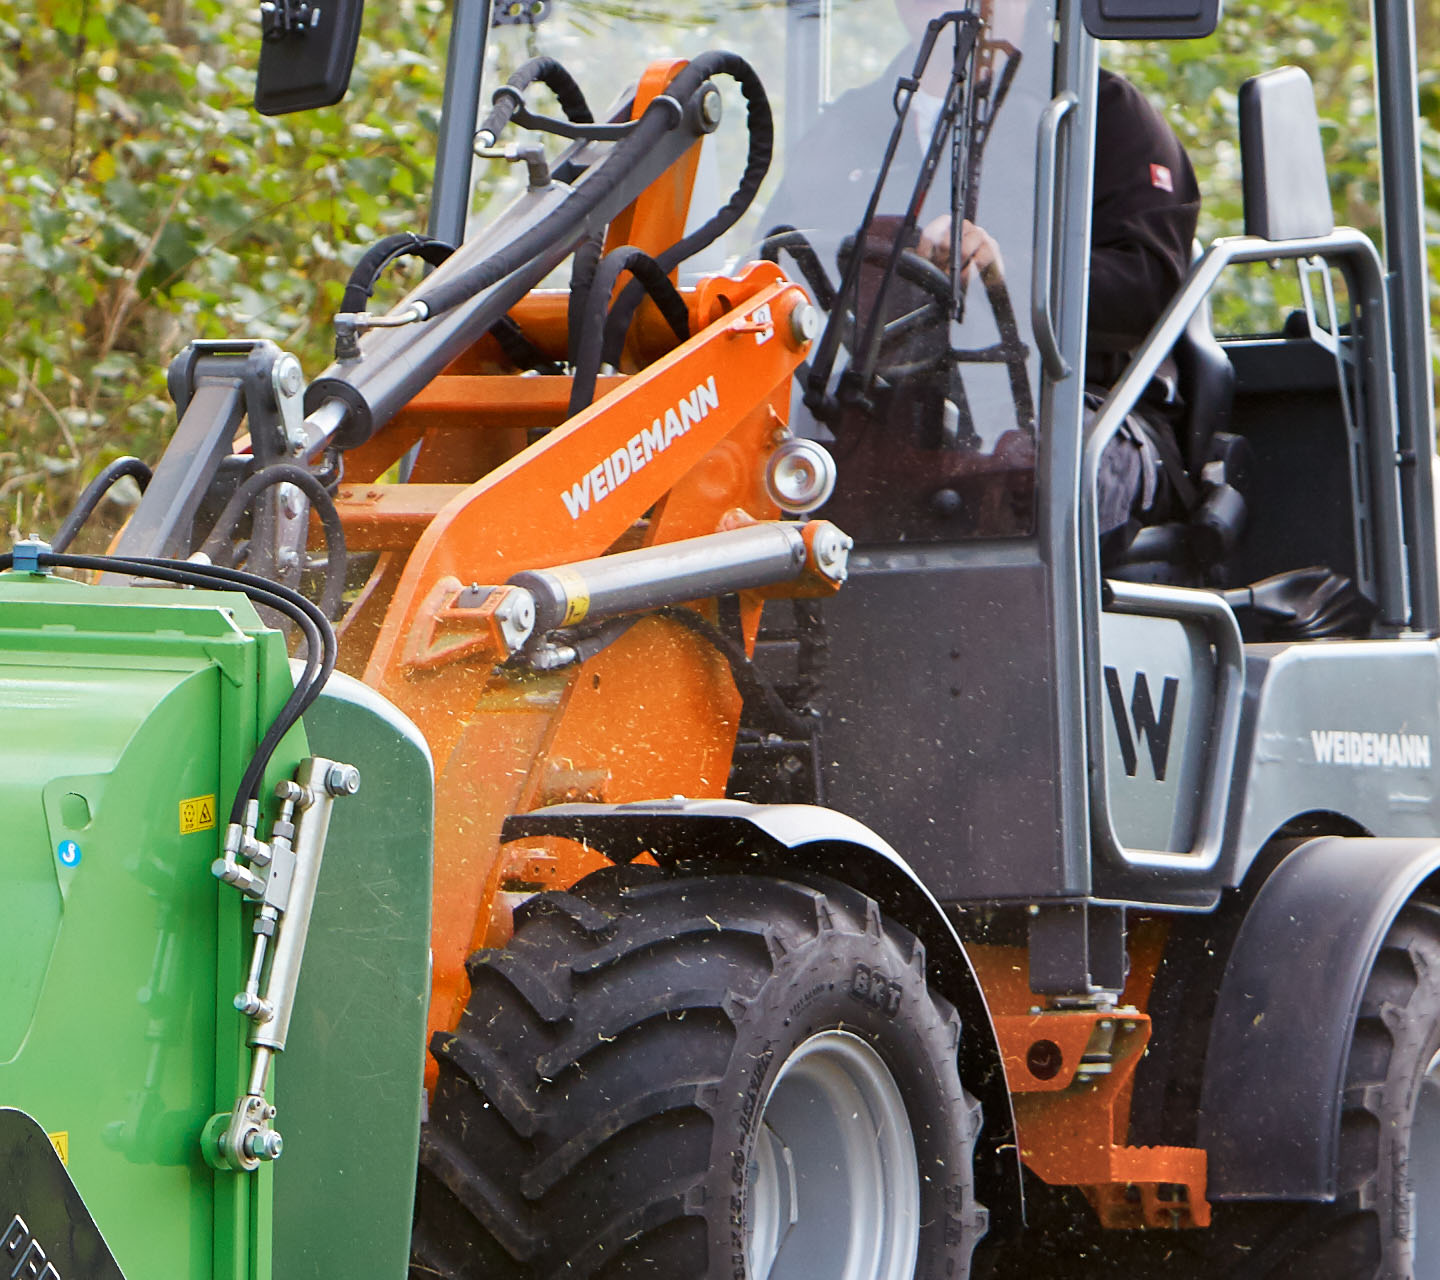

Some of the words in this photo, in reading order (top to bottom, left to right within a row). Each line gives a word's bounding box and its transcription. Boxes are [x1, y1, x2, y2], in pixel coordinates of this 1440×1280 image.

[559, 375, 720, 520] WEIDEMANN
[1103, 665, 1180, 782] W
[1311, 729, 1431, 768] WEIDEMANN
[849, 962, 903, 1019] BKT
